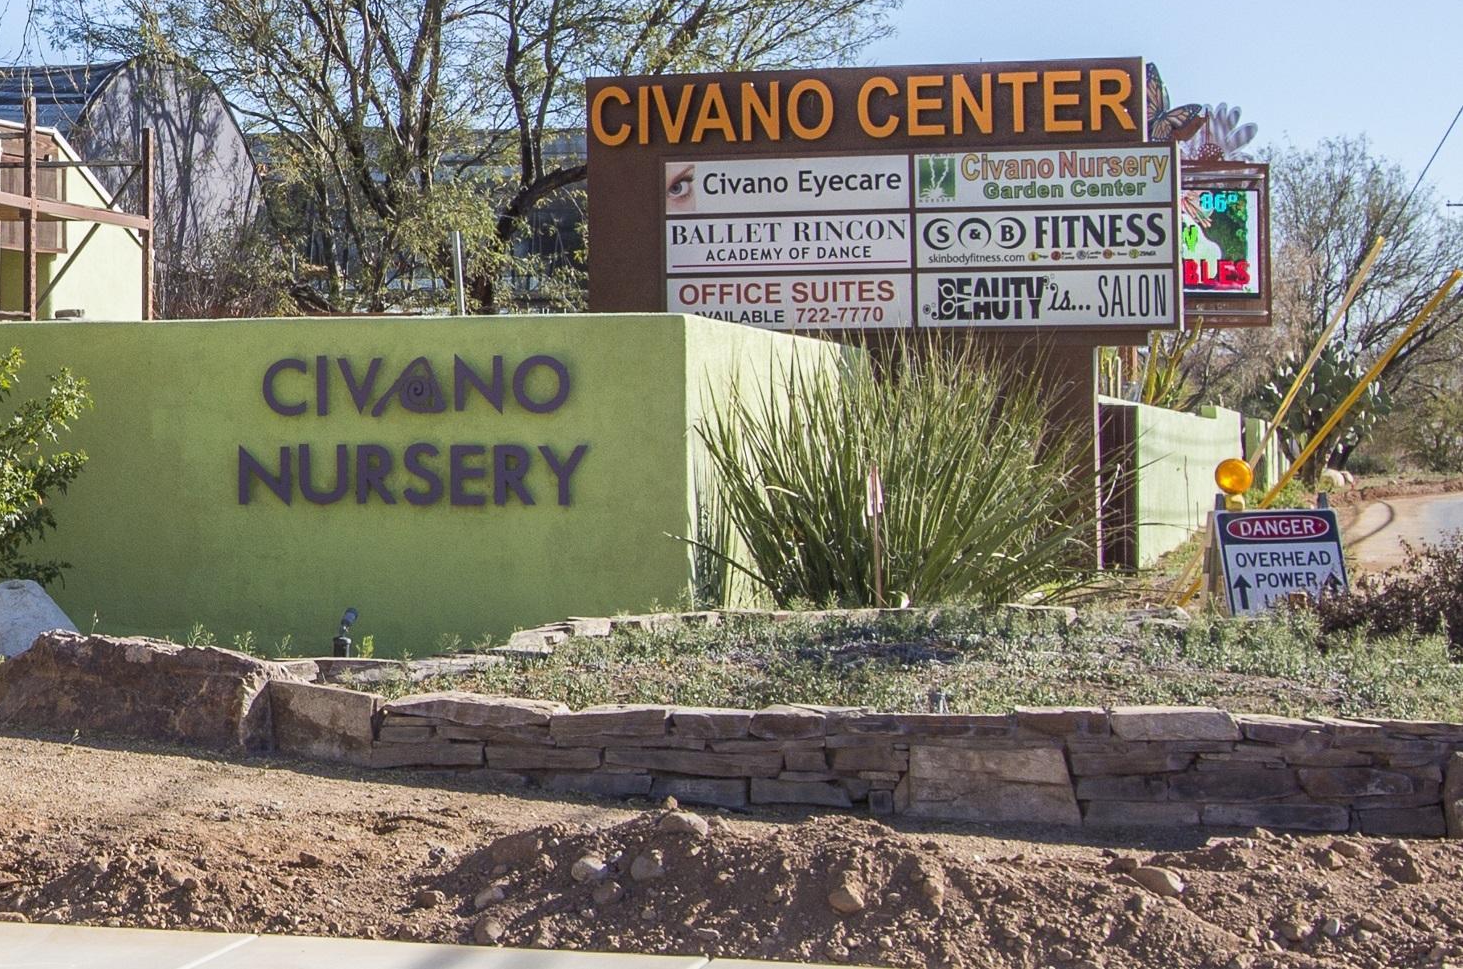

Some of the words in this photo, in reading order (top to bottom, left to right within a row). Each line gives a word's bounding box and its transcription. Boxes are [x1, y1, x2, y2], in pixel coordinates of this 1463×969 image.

[591, 79, 835, 147] CIVANO
[857, 68, 1136, 139] CENTER
[961, 153, 1054, 181] Civano
[1059, 151, 1169, 183] Nursery
[703, 172, 788, 195] Civano
[798, 170, 902, 197] Eyecare
[983, 182, 1064, 200] Garden
[1070, 179, 1146, 197] Center
[671, 222, 782, 245] BALLET
[793, 219, 907, 242] RINCON
[1034, 213, 1167, 249] FITNESS
[705, 247, 783, 262] ACADEMY
[788, 247, 809, 260] OF
[817, 245, 872, 259] DANCE
[928, 252, 1026, 265] skinbodyfitness.com
[679, 282, 782, 305] OFFICE
[791, 280, 895, 303] SUITES
[937, 276, 1046, 321] BEAUTY
[1097, 274, 1167, 318] SALON
[795, 306, 883, 324] 722-7770
[262, 353, 571, 417] CIVANO
[238, 442, 589, 507] NURSERY
[1239, 518, 1316, 537] DANGER
[1235, 550, 1332, 569] OVERHEAD
[1255, 572, 1318, 589] POWER
